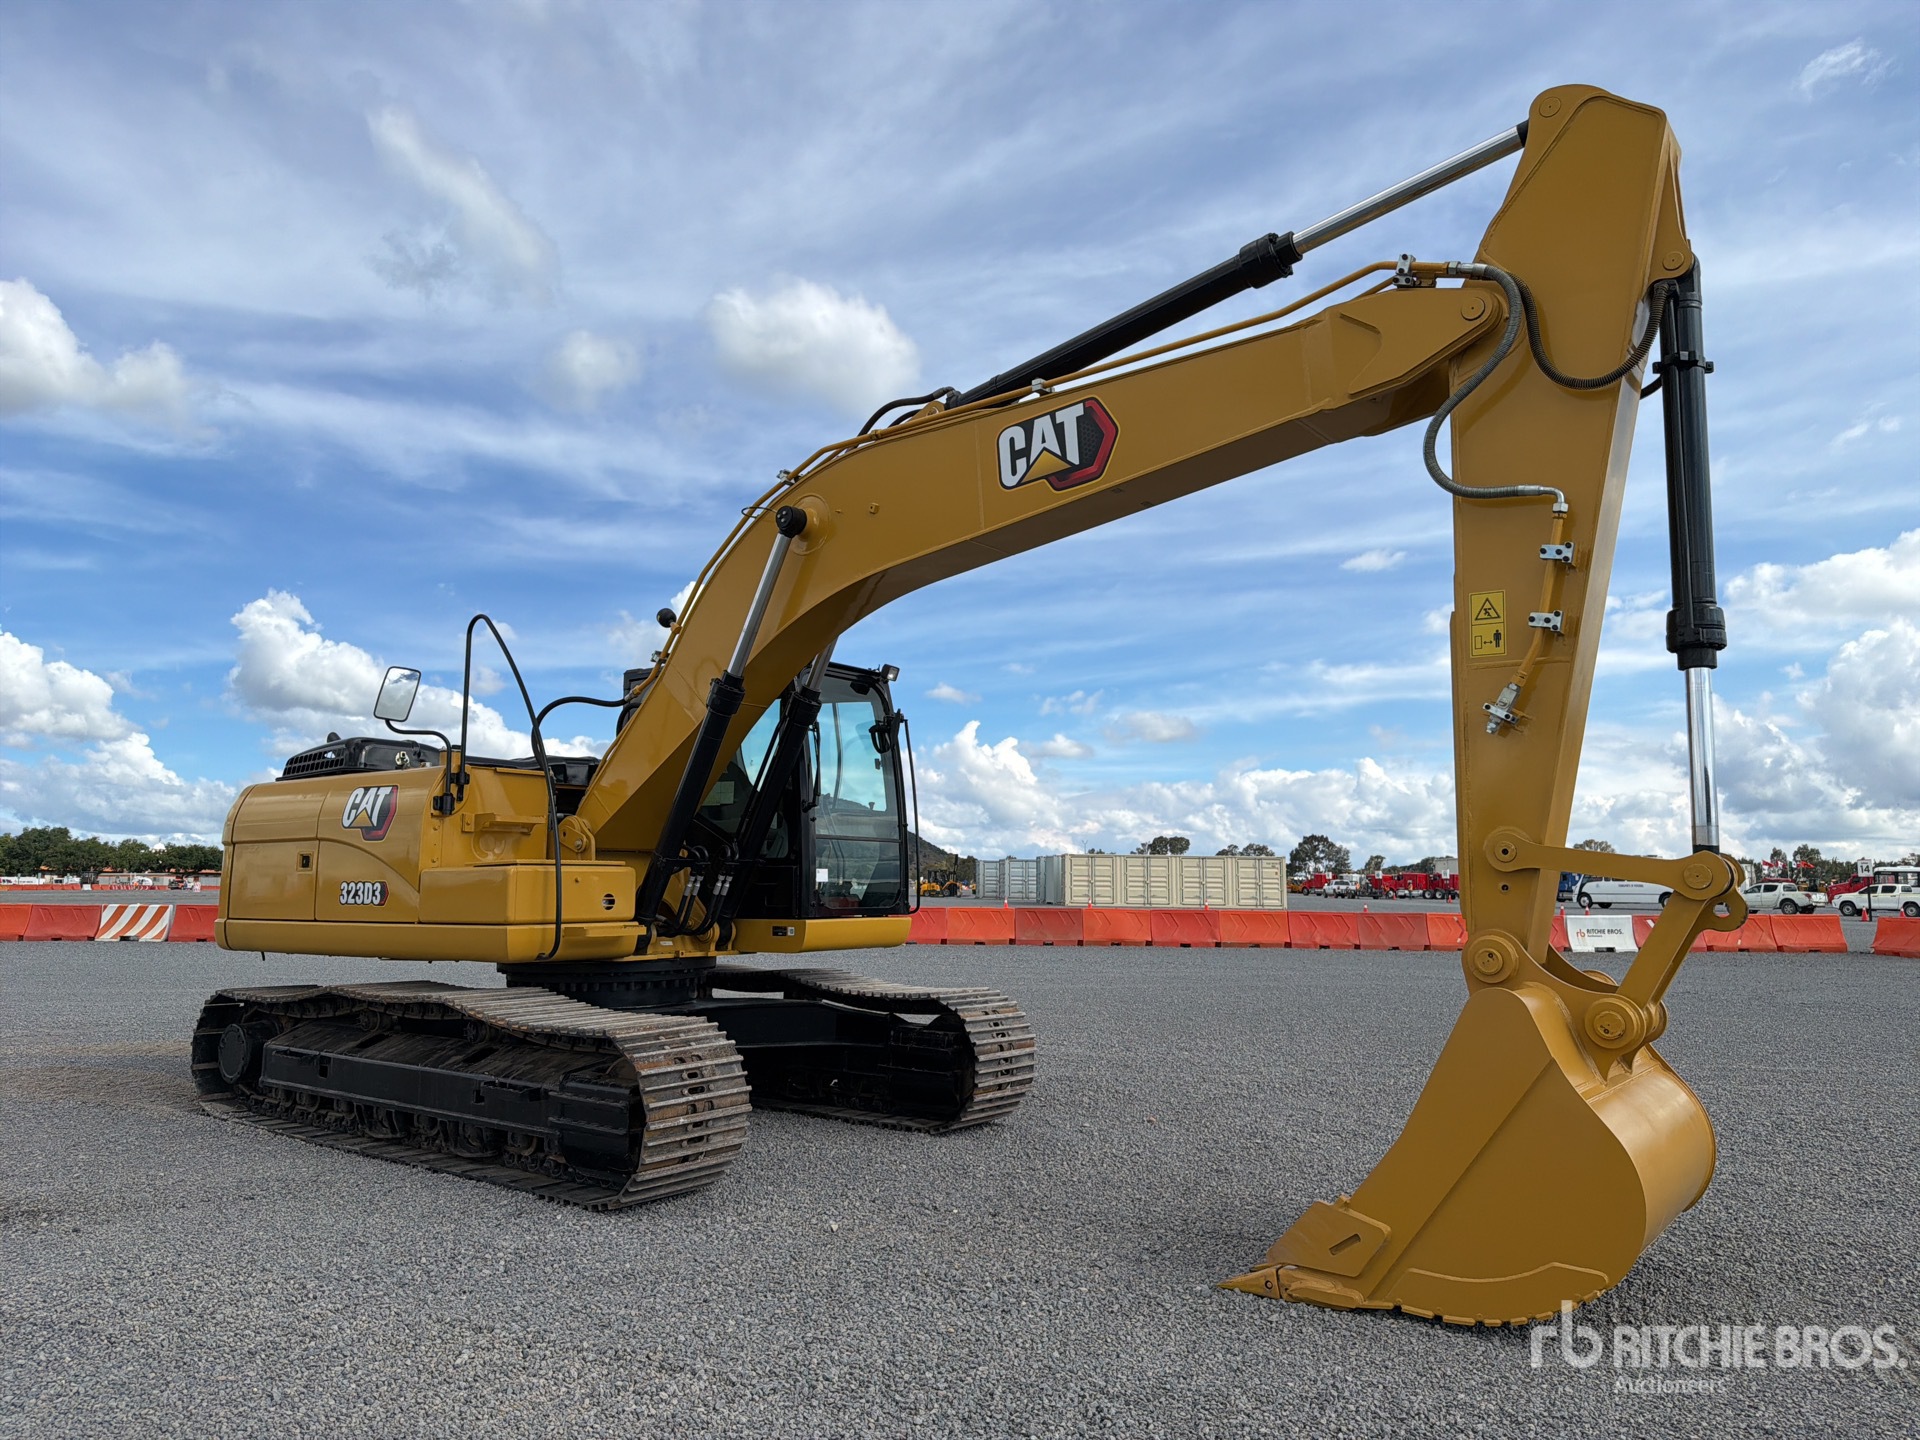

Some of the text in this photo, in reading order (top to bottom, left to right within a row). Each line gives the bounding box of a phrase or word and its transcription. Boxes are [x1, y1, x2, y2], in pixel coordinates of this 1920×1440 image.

[998, 402, 1085, 487] CAT
[342, 786, 393, 828] CAT
[1860, 865, 1870, 874] 14
[340, 882, 381, 905] 323D3
